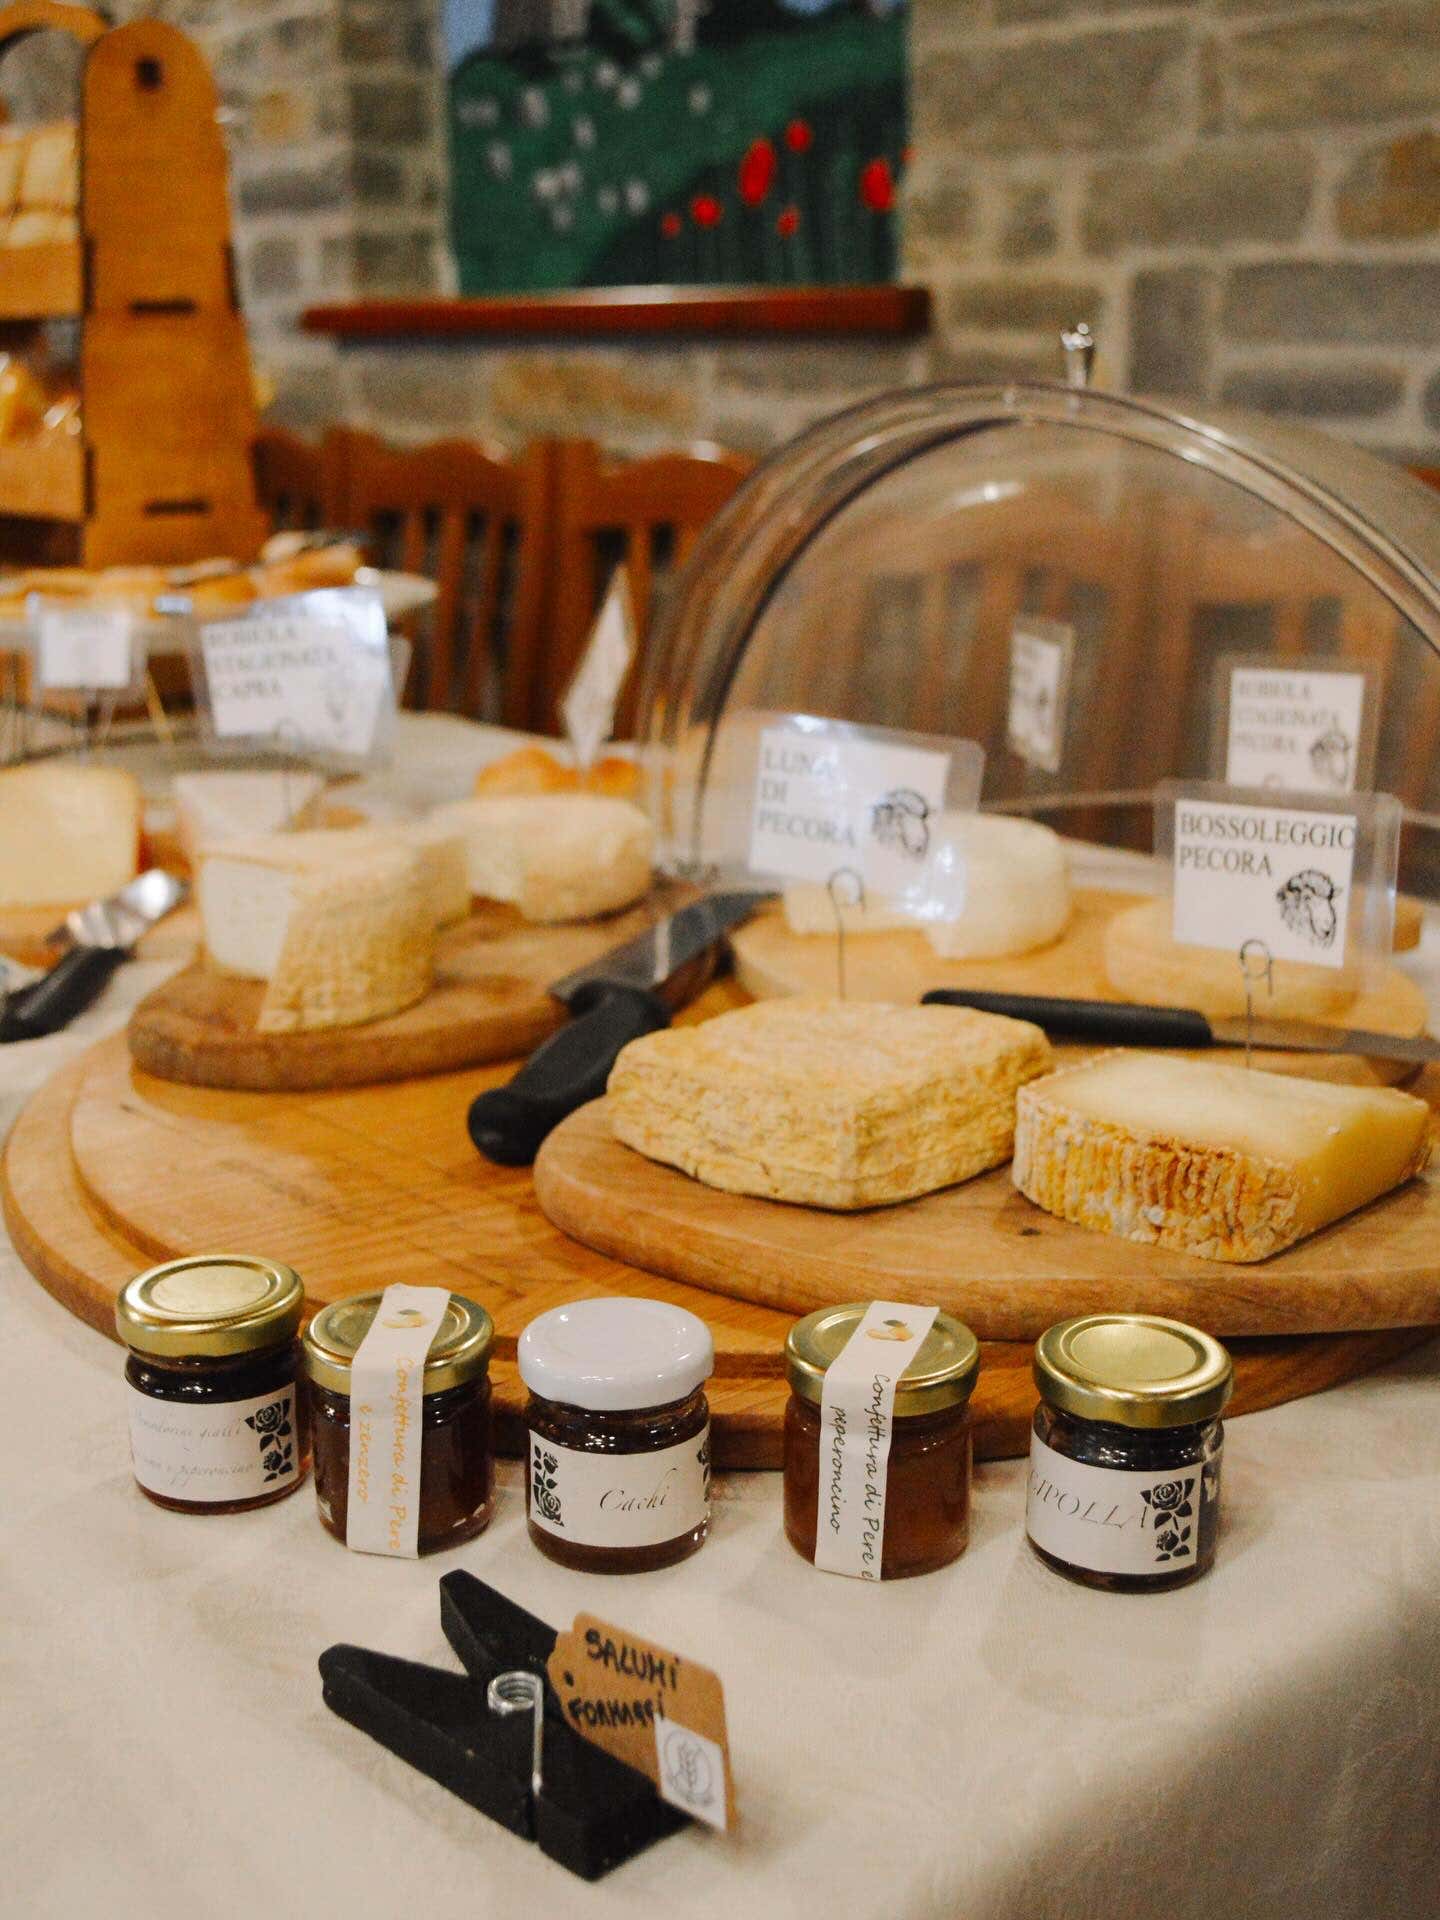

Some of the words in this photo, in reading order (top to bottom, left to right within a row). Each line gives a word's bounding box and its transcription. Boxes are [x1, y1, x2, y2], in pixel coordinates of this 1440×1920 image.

[758, 809, 856, 847] PECORA
[1180, 845, 1273, 877] PECORA
[864, 1373, 891, 1479] Confettura
[599, 1467, 678, 1513] Cachi
[829, 1405, 848, 1536] peperoncino
[864, 1483, 881, 1510] di
[861, 1516, 881, 1565] Pere
